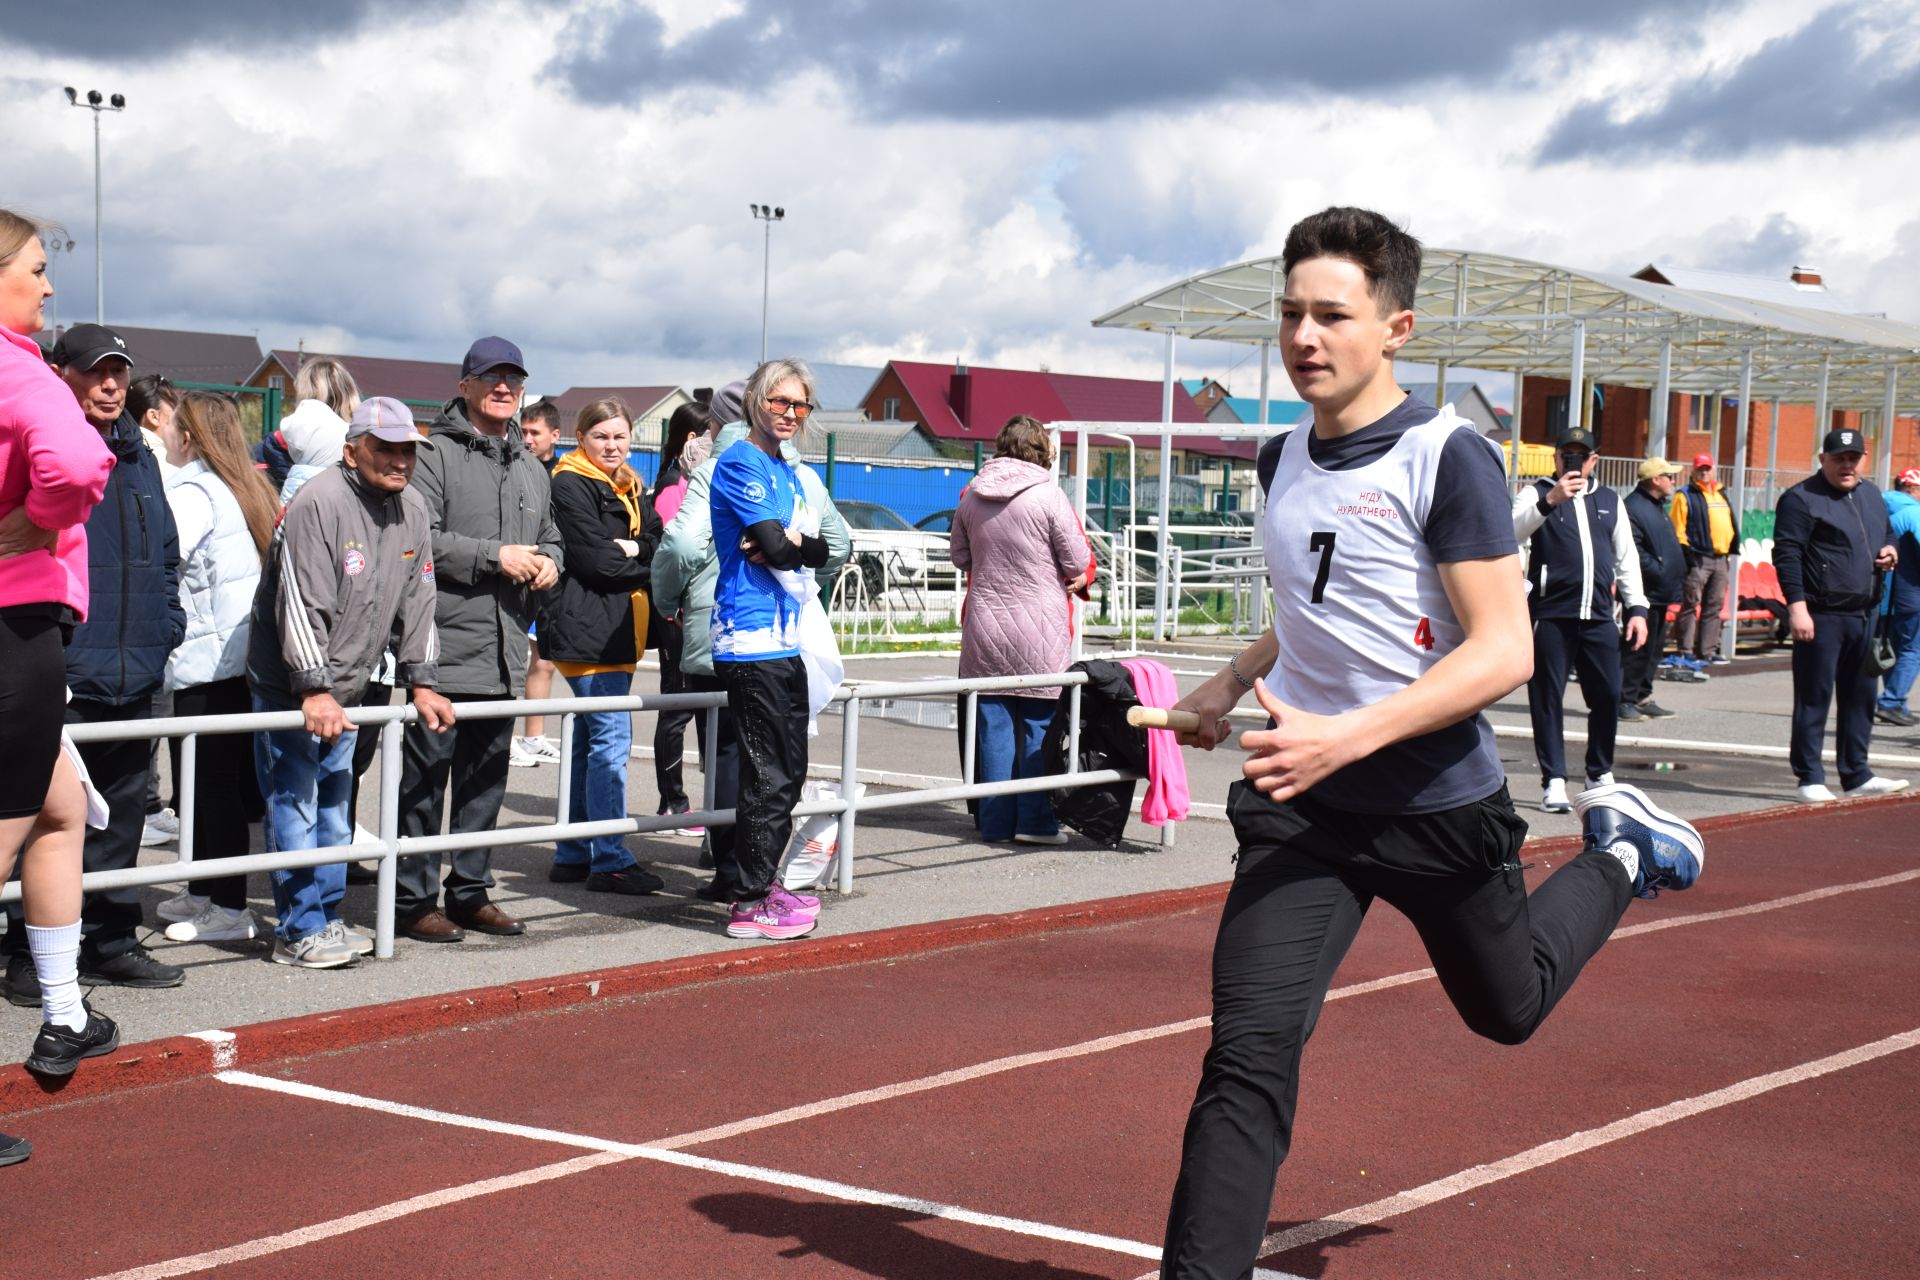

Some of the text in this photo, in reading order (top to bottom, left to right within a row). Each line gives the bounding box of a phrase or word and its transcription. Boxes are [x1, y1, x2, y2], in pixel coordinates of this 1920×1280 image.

[1360, 492, 1382, 503] НГДУ
[1337, 505, 1398, 519] НУРЛАТНЕФТЬ
[1310, 532, 1336, 604] 7
[1414, 617, 1435, 650] 4
[753, 915, 779, 926] HOKA
